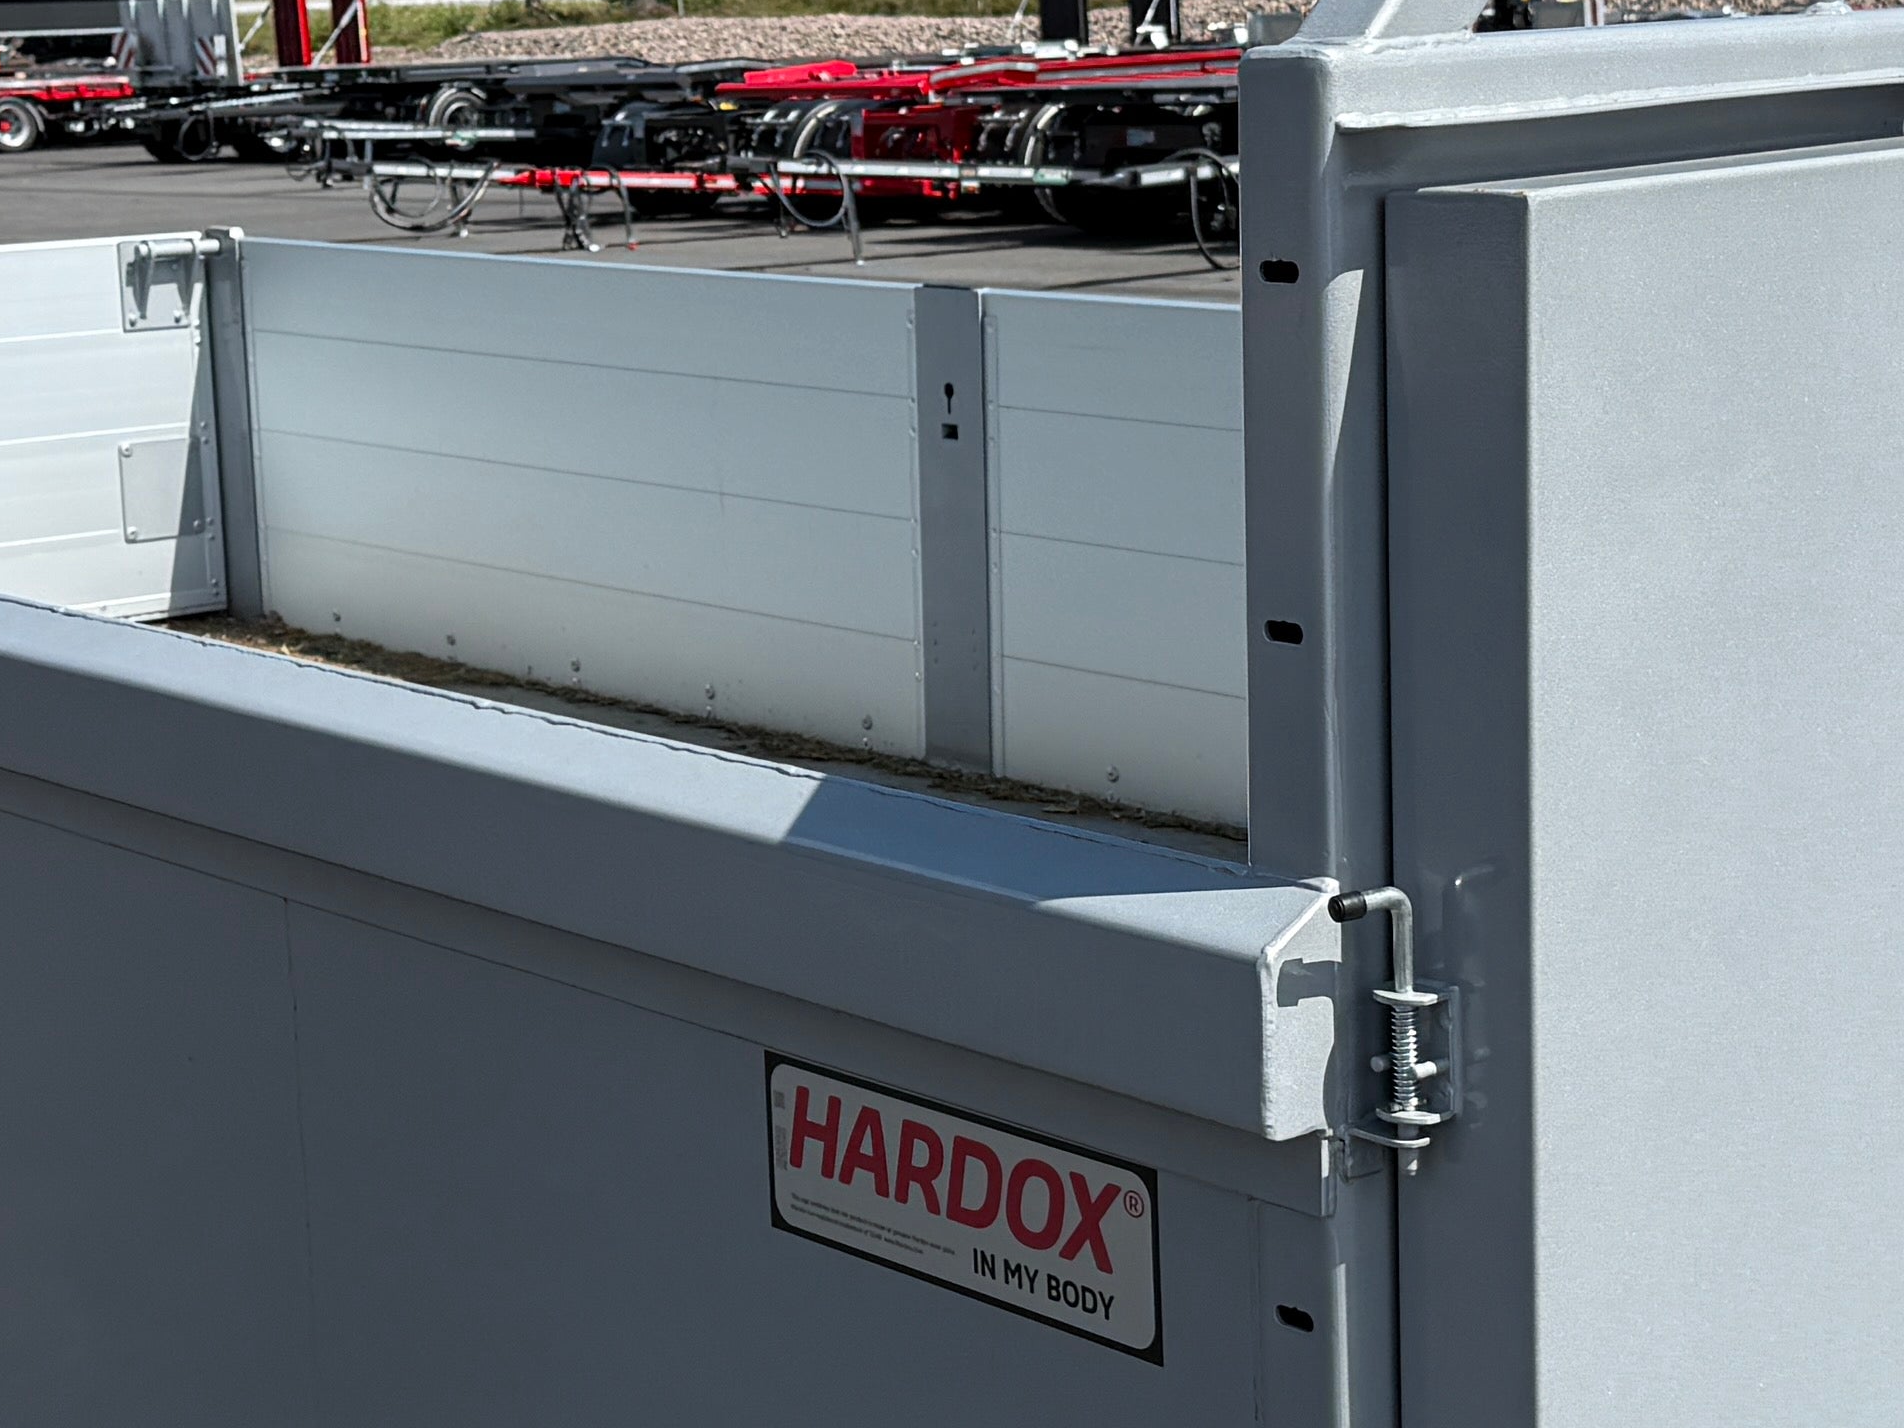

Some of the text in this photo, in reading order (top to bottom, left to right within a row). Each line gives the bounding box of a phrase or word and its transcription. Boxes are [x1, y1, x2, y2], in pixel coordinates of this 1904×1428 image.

[973, 1247, 1114, 1321] IN MY BODY
